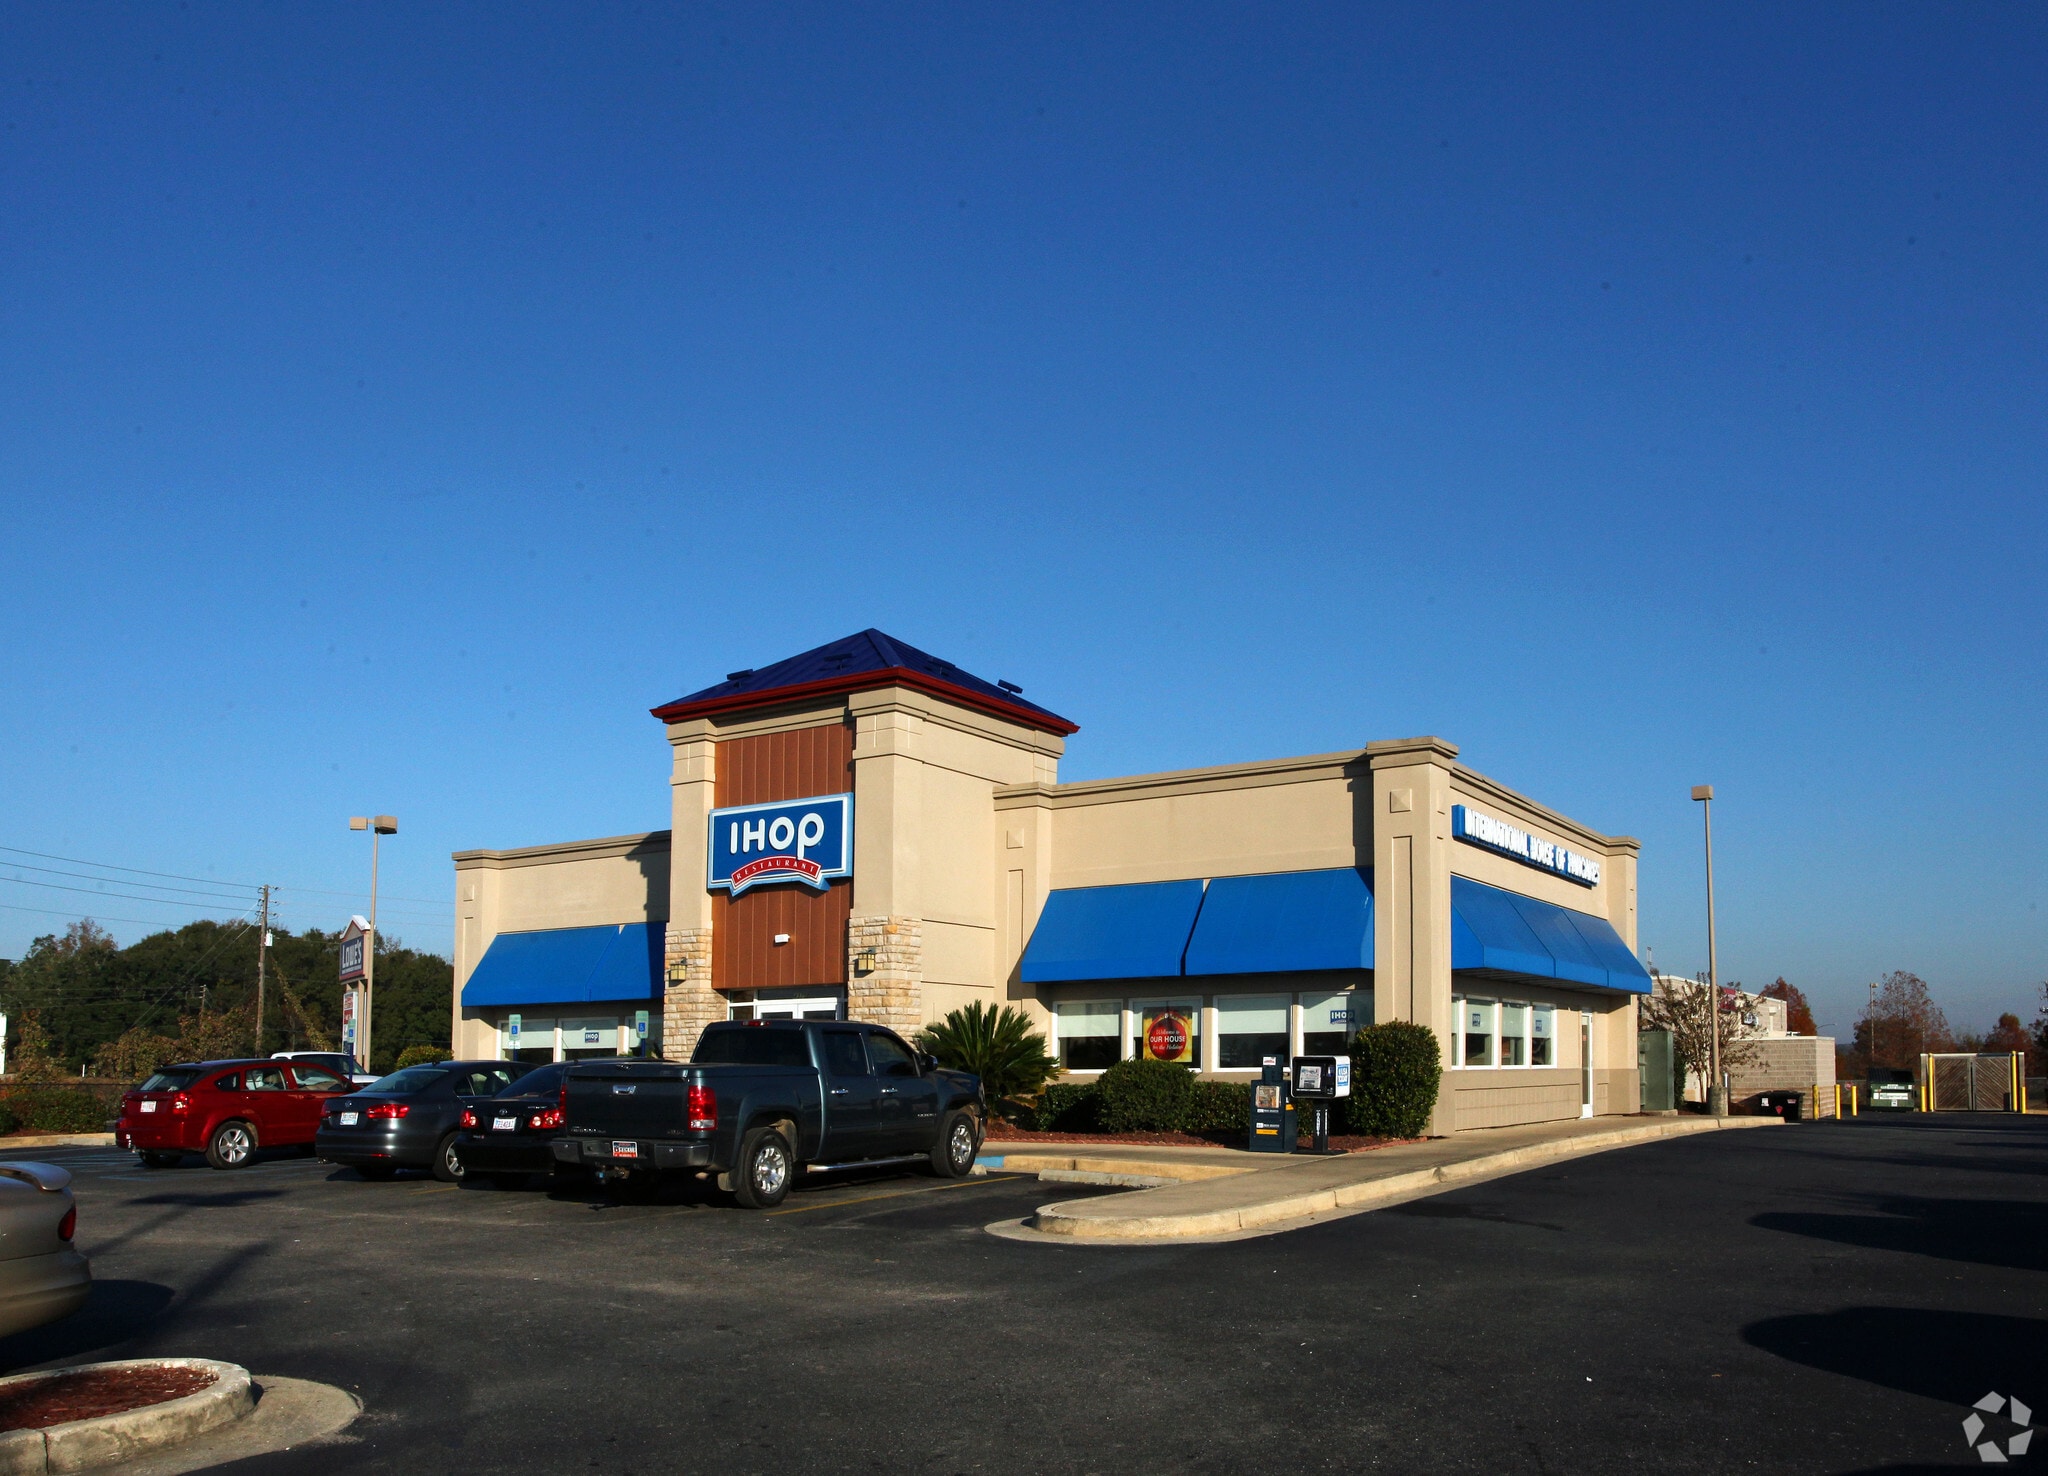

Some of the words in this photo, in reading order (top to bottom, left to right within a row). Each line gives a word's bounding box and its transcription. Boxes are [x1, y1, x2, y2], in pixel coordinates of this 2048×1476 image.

[730, 812, 825, 860] IHOP
[1464, 807, 1529, 857] INTERNATIONAL
[1530, 835, 1555, 867] HOUSE
[1555, 847, 1566, 872] OF
[1567, 851, 1600, 885] PANCAKES
[736, 860, 815, 880] RESTAURANT
